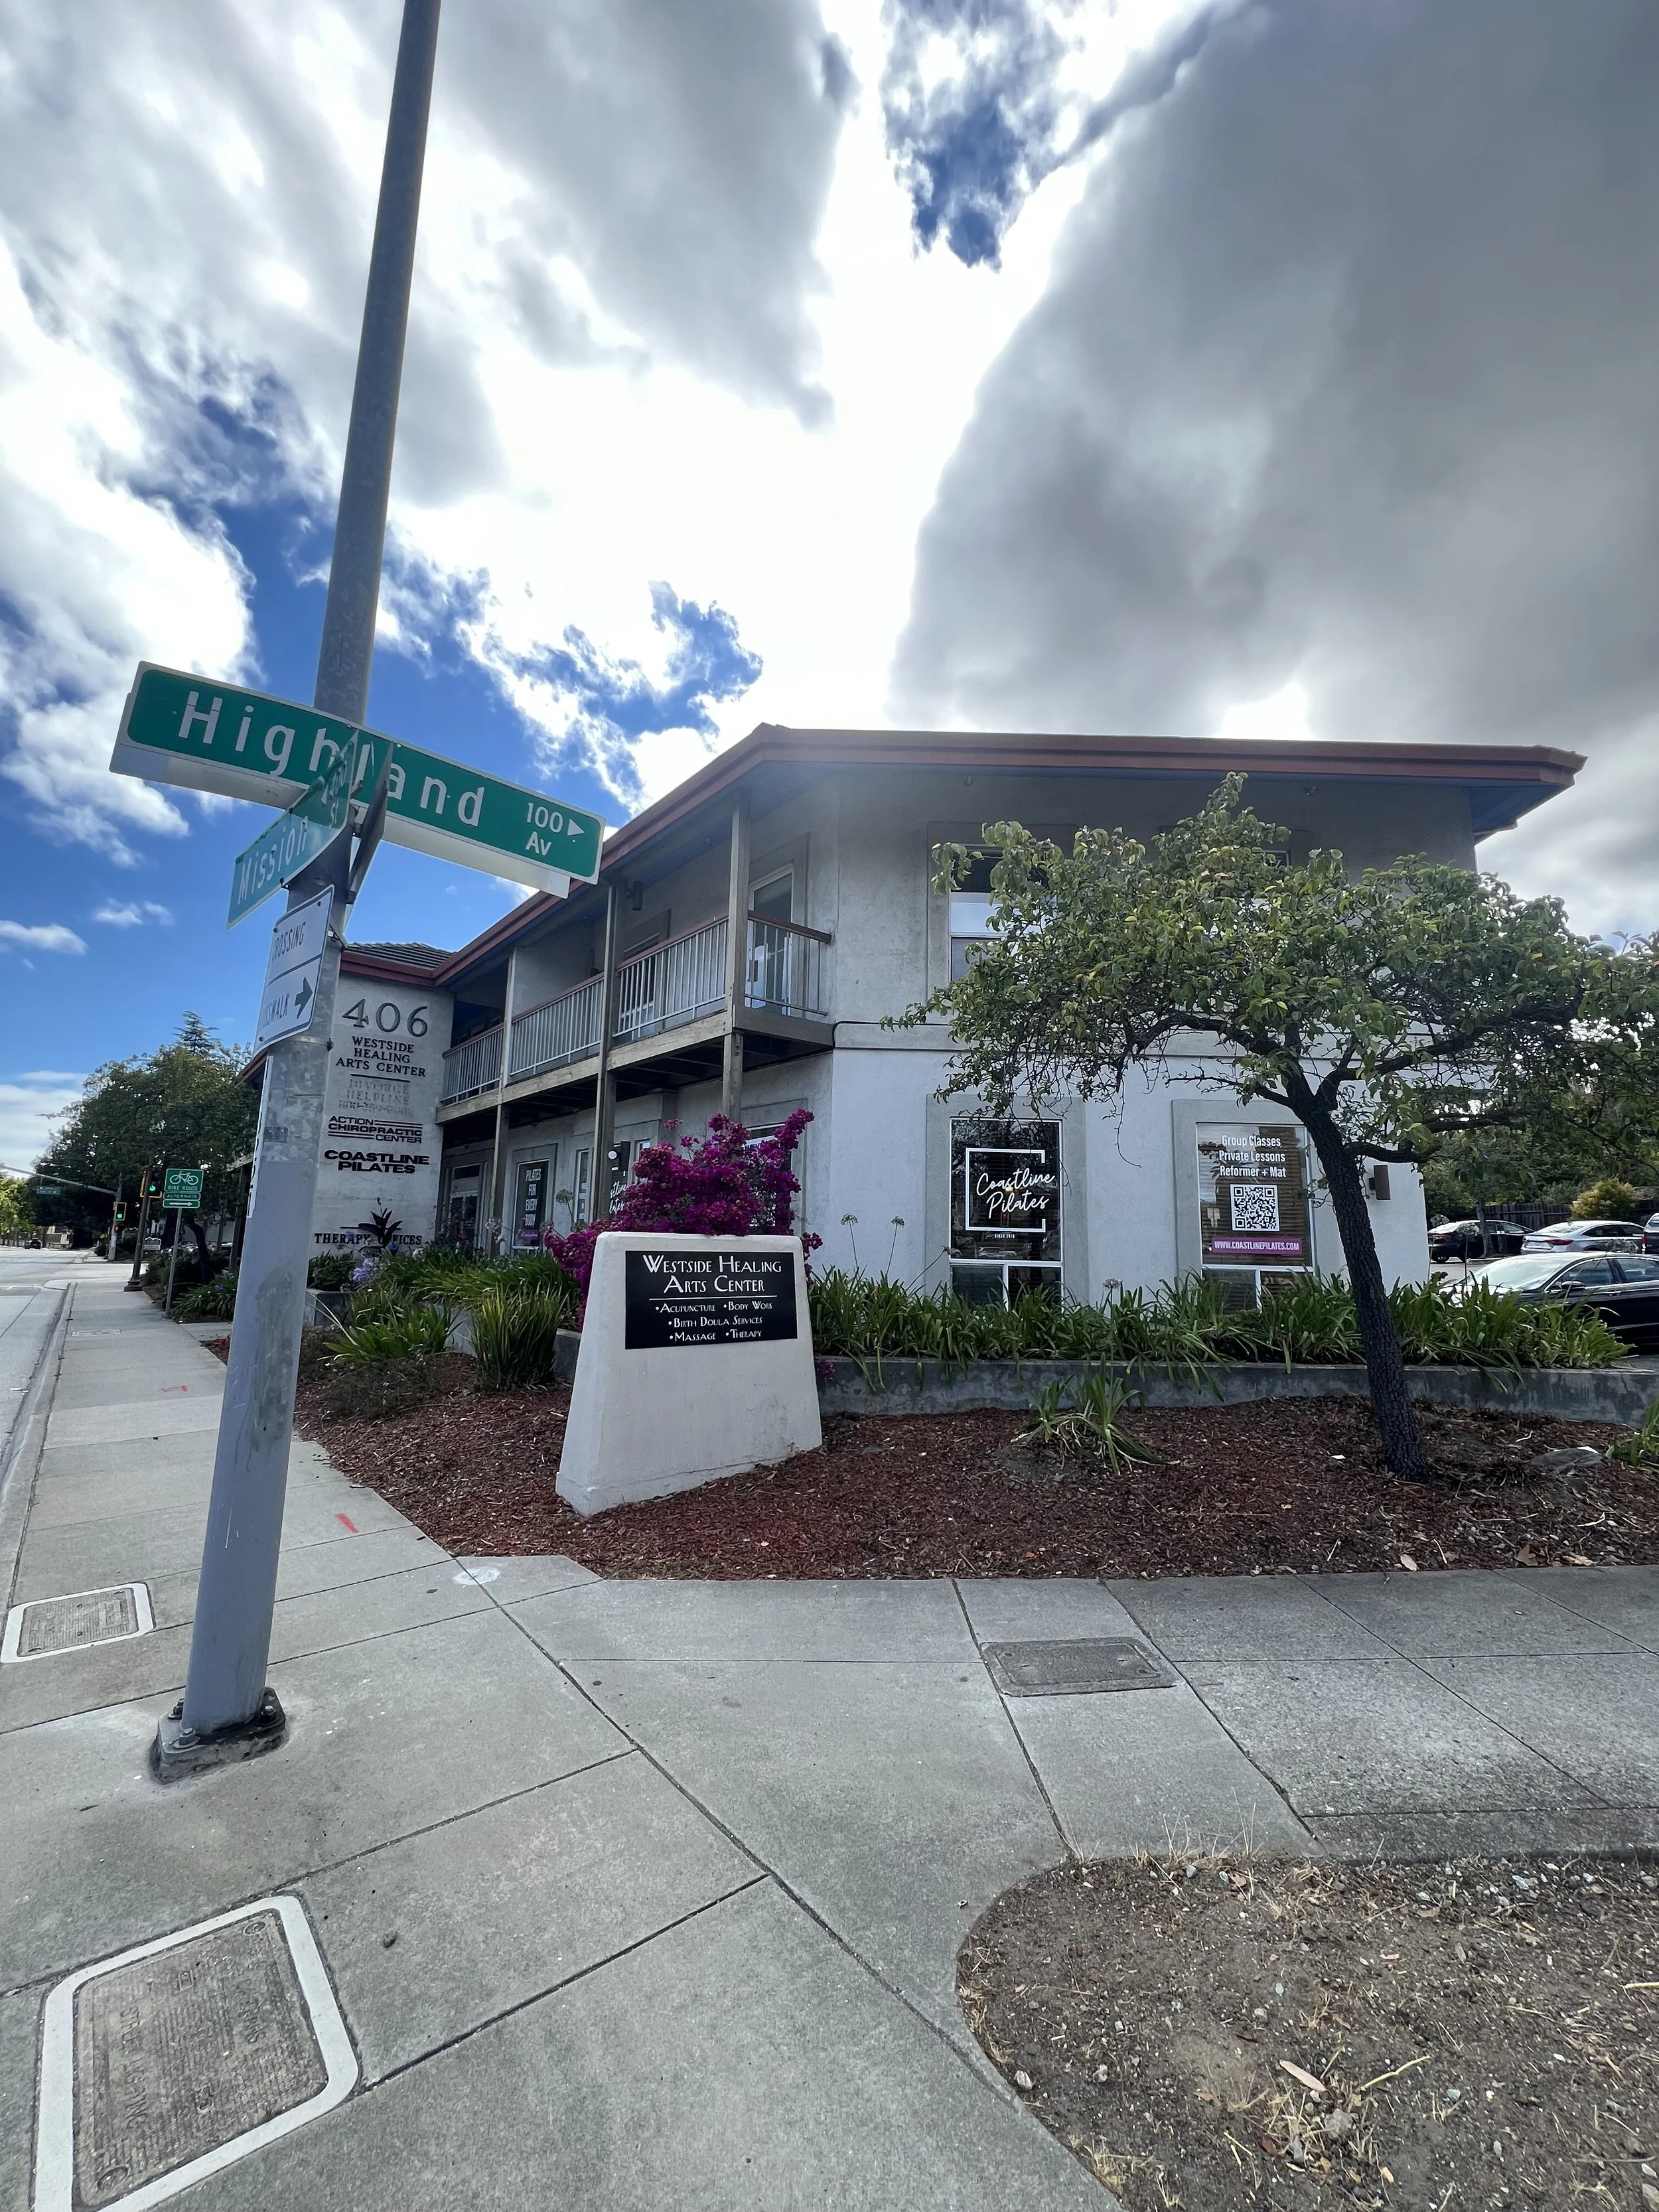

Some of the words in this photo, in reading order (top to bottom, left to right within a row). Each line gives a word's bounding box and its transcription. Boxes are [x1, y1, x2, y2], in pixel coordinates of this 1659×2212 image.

[178, 691, 484, 827] Highland
[526, 802, 563, 834] 100
[238, 815, 308, 905] Mission
[328, 798, 339, 830] St
[525, 832, 552, 856] Av
[342, 998, 428, 1037] 406
[352, 1036, 414, 1053] WESTSIDE
[354, 1047, 410, 1063] HEALING
[335, 1057, 370, 1070] ARTS
[376, 1062, 426, 1077] CENTER
[329, 1116, 374, 1126] ACTION
[328, 1123, 423, 1137] CHIROPRACTIC
[375, 1134, 422, 1144] CENTER
[1222, 1135, 1248, 1147] Group
[1248, 1136, 1281, 1147] Classes
[324, 1149, 430, 1165] COASTLINE
[1219, 1150, 1249, 1161] Private
[1250, 1151, 1285, 1162] Lessons
[338, 1161, 415, 1174] PILATES
[1220, 1165, 1260, 1177] Reformer
[1270, 1166, 1287, 1177] Mat
[976, 1167, 1055, 1196] Coastline
[986, 1191, 1050, 1219] Pilates
[315, 1233, 371, 1244] THERAPY
[378, 1234, 423, 1245] OFICES
[1214, 1240, 1299, 1252] WWW.COASTLINEPILATES.COM
[643, 1254, 712, 1273] WESTSIDE
[719, 1255, 782, 1273] HEALING
[664, 1275, 707, 1293] ARTS
[714, 1275, 764, 1292] CENTER
[660, 1303, 716, 1313] ACUPUNCTURE
[728, 1301, 749, 1311] BODY
[751, 1300, 773, 1310] WORK
[674, 1317, 697, 1328] BIRTH
[700, 1317, 729, 1327] DOULA
[733, 1315, 762, 1325] SERVICES
[675, 1331, 716, 1342] MASSAGE
[730, 1329, 762, 1339] THERAPY
